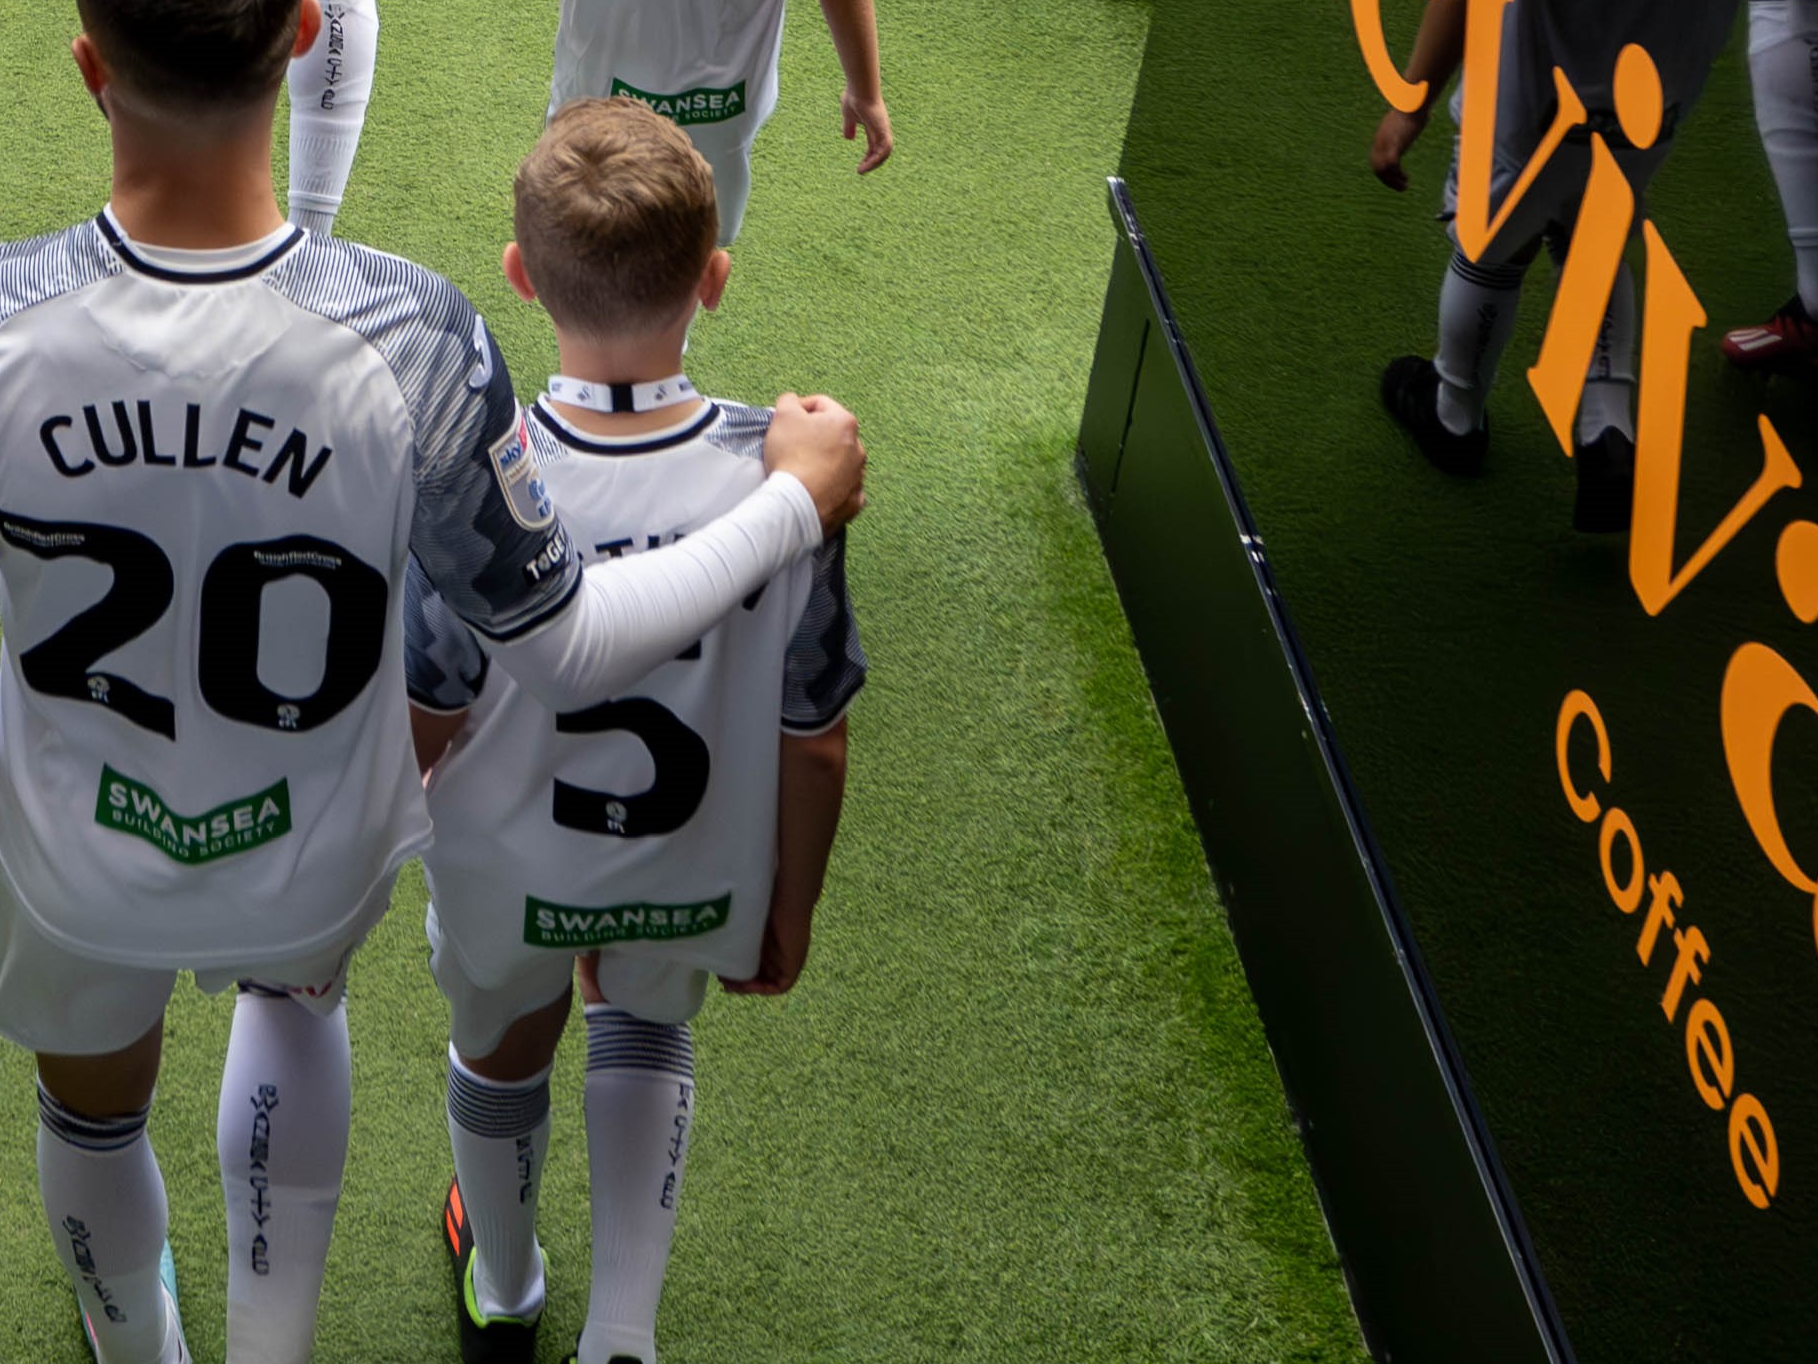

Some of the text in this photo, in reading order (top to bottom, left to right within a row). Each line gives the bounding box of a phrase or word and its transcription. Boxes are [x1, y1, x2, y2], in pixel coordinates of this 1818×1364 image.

[38, 399, 334, 499] CULLEN
[499, 444, 522, 467] sky
[105, 773, 284, 848] SWANSEA
[196, 822, 279, 860] SOCIETY
[535, 901, 721, 934] SWANSEA
[540, 922, 628, 944] BUILDING
[1555, 688, 1780, 1211] Coffee
